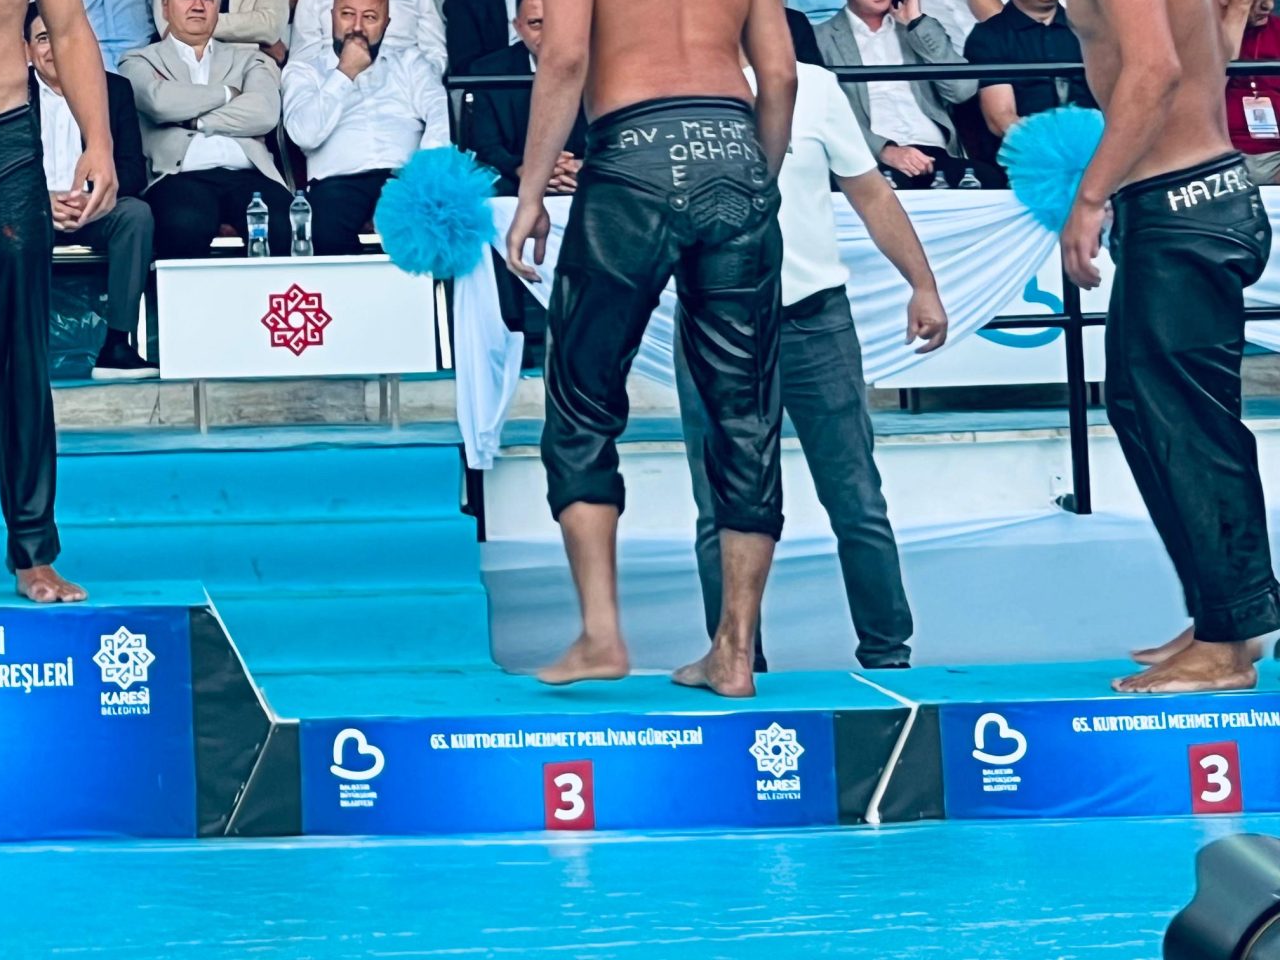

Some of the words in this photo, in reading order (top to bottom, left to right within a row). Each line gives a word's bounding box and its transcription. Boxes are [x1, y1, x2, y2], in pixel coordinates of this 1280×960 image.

[430, 733, 450, 749] 65.
[451, 729, 523, 749] KURTDERELİ
[525, 732, 576, 747] MEHMET
[577, 728, 636, 746] PEHLİVAN
[1072, 717, 1092, 732] 65.
[1093, 712, 1166, 732] KURTDERELİ
[1168, 713, 1219, 729] MEHMET
[1199, 754, 1232, 803] 3
[553, 772, 586, 821] 3
